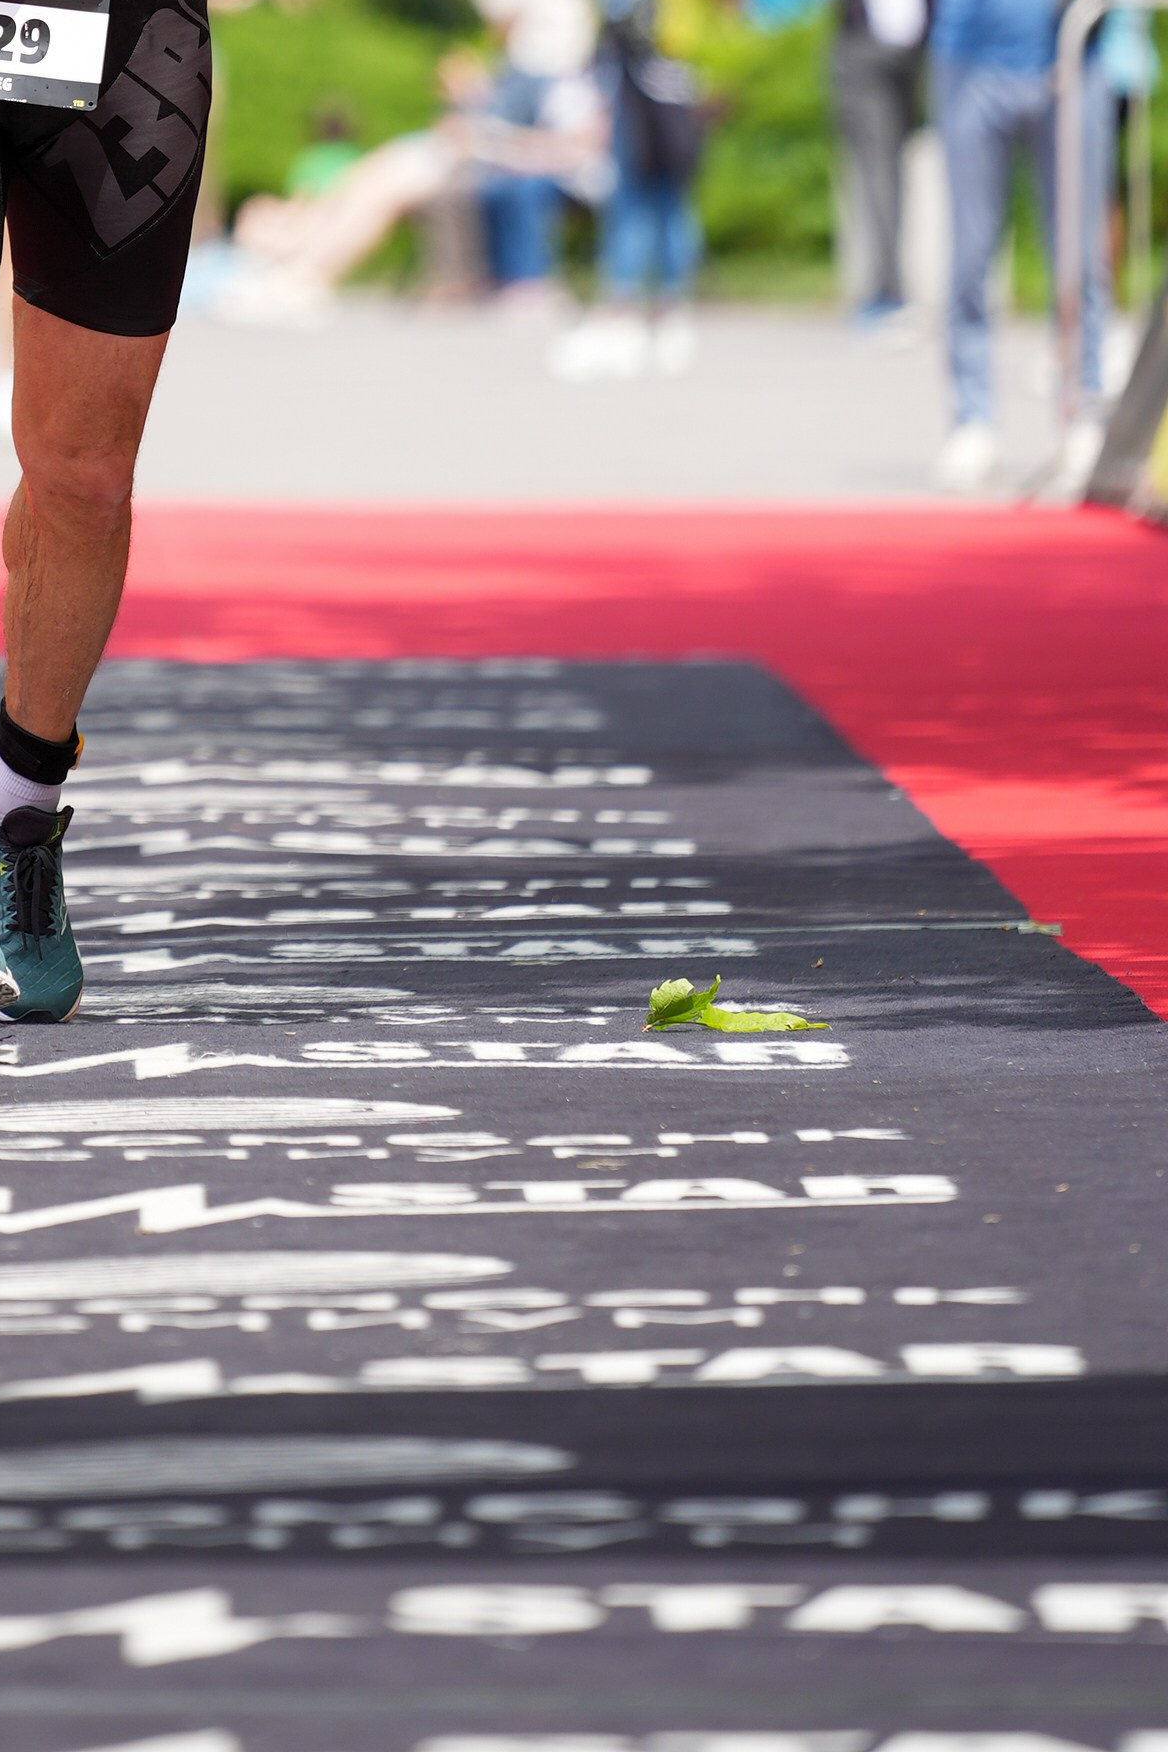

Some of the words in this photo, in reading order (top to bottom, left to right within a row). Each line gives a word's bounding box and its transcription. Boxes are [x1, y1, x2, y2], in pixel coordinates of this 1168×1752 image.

[268, 937, 758, 958] STAR
[299, 1041, 851, 1064] STAR
[329, 1174, 957, 1206] STAR
[359, 1342, 1086, 1386] STAR
